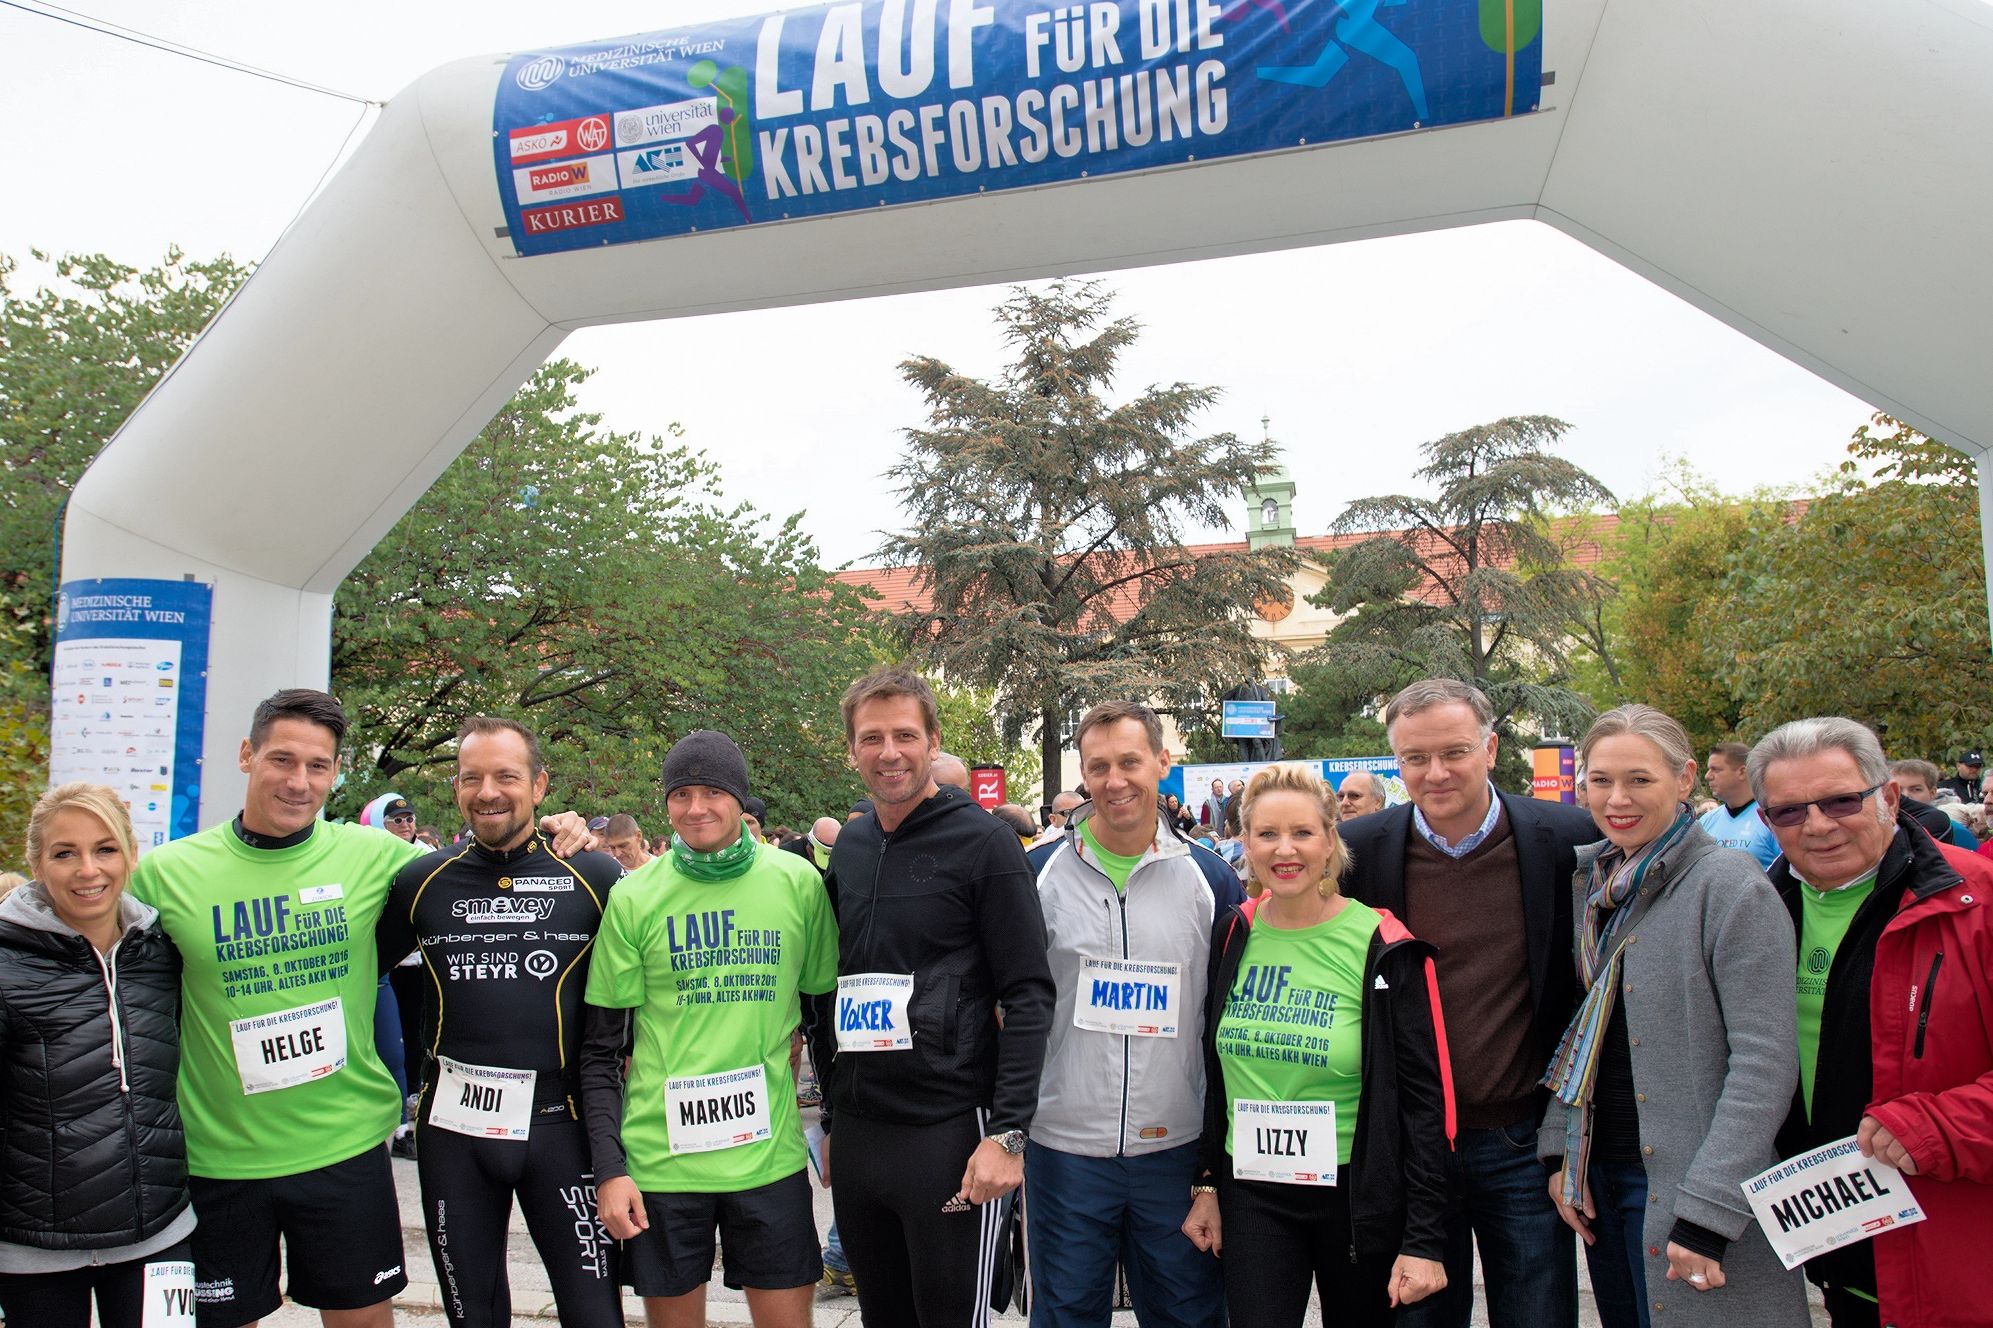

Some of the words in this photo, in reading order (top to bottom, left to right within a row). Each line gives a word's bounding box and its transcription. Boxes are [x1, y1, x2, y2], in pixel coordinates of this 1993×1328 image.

[569, 48, 675, 77] UNIVERSITÄT
[680, 40, 725, 58] WIEN
[571, 36, 689, 64] MEDIZINISCHE
[755, 0, 994, 119] LAUF
[1025, 5, 1123, 78] FÜR
[1140, 0, 1224, 60] DIE
[645, 103, 713, 126] universität
[579, 122, 607, 149] WAT
[647, 122, 681, 137] wien
[759, 59, 1228, 199] KREBSFORSCHUNG
[516, 136, 547, 153] ASKÖ
[532, 170, 569, 185] RADIO
[571, 166, 587, 180] W
[549, 188, 571, 196] RADIO
[573, 184, 592, 193] WIEN
[529, 202, 619, 231] KURIER
[71, 595, 152, 608] MEDIZINISCHE
[70, 606, 139, 623] UNIVERSITÄT
[144, 611, 184, 624] WIEN
[514, 877, 572, 886] PANACEO
[212, 894, 290, 944] LAUF
[294, 910, 322, 931] FÜR
[324, 906, 347, 925] DIE
[667, 909, 735, 953] LAUF
[737, 929, 760, 947] FÜR
[763, 930, 781, 947] DIE
[215, 924, 349, 962] KREBSFORSCHUNG!
[422, 933, 518, 946] kühberger
[523, 931, 540, 941] &
[544, 931, 590, 941] haas
[273, 963, 283, 975] 8.
[285, 955, 326, 972] OKTOBER
[329, 950, 349, 964] 2016
[446, 952, 475, 964] WIR
[481, 952, 519, 964] SIND
[670, 948, 781, 972] KREBSFORSCHUNG!
[1085, 960, 1099, 968] LAUF
[1100, 961, 1111, 970] FÜR
[1113, 963, 1123, 971] DIE
[1124, 964, 1178, 975] KREBSFORSCHUNG!
[225, 984, 251, 998] 10-14
[278, 974, 306, 990] ALTES
[308, 969, 327, 984] AKH
[328, 964, 349, 980] WIEN
[450, 964, 518, 981] STEYR
[714, 976, 722, 988] 8.
[724, 974, 760, 987] OKTOBER
[862, 978, 910, 987] KREBSFORSCHUNG!
[716, 989, 741, 1003] ALTES
[743, 990, 759, 1002] AKH
[1091, 979, 1168, 1011] MARTIN
[1230, 965, 1291, 1003] LAUF
[1288, 988, 1312, 1007] FÜR
[1314, 991, 1339, 1011] DIE
[236, 1022, 251, 1032] LAUF
[253, 1019, 265, 1029] FÜR
[266, 1017, 278, 1027] DIE
[279, 1000, 338, 1023] KREBSFORSCHUNG!
[1225, 1001, 1334, 1029] KREBSFORSCHUNG!
[260, 1027, 325, 1064] HELGE
[1254, 1031, 1262, 1043] 8.
[1264, 1032, 1302, 1047] OKTOBER
[1305, 1036, 1329, 1051] 2016
[1256, 1045, 1280, 1061] ALTES
[1282, 1050, 1299, 1064] AKH
[1302, 1053, 1328, 1068] WIEN
[464, 1066, 474, 1075] DIE
[669, 1081, 682, 1090] LAUF
[683, 1080, 695, 1089] FÜR
[696, 1079, 706, 1087] DIE
[707, 1068, 762, 1086] KREBSFORSCHUNG!
[460, 1082, 503, 1112] ANDI
[680, 1090, 756, 1126] MARKUS
[1237, 1103, 1249, 1112] LAUF
[1250, 1104, 1259, 1112] FÜR
[1260, 1104, 1270, 1114] DIE
[1257, 1127, 1307, 1156] LIZZY
[1749, 1177, 1768, 1194] LAUF
[1769, 1170, 1785, 1185] FÜR
[1783, 1163, 1798, 1178] DIE
[942, 1203, 971, 1213] adidas
[1771, 1168, 1890, 1233] MICHAEL
[438, 1200, 446, 1232] haas
[438, 1234, 447, 1247] &
[559, 1186, 601, 1279] SPORT
[441, 1249, 465, 1319] kühberger
